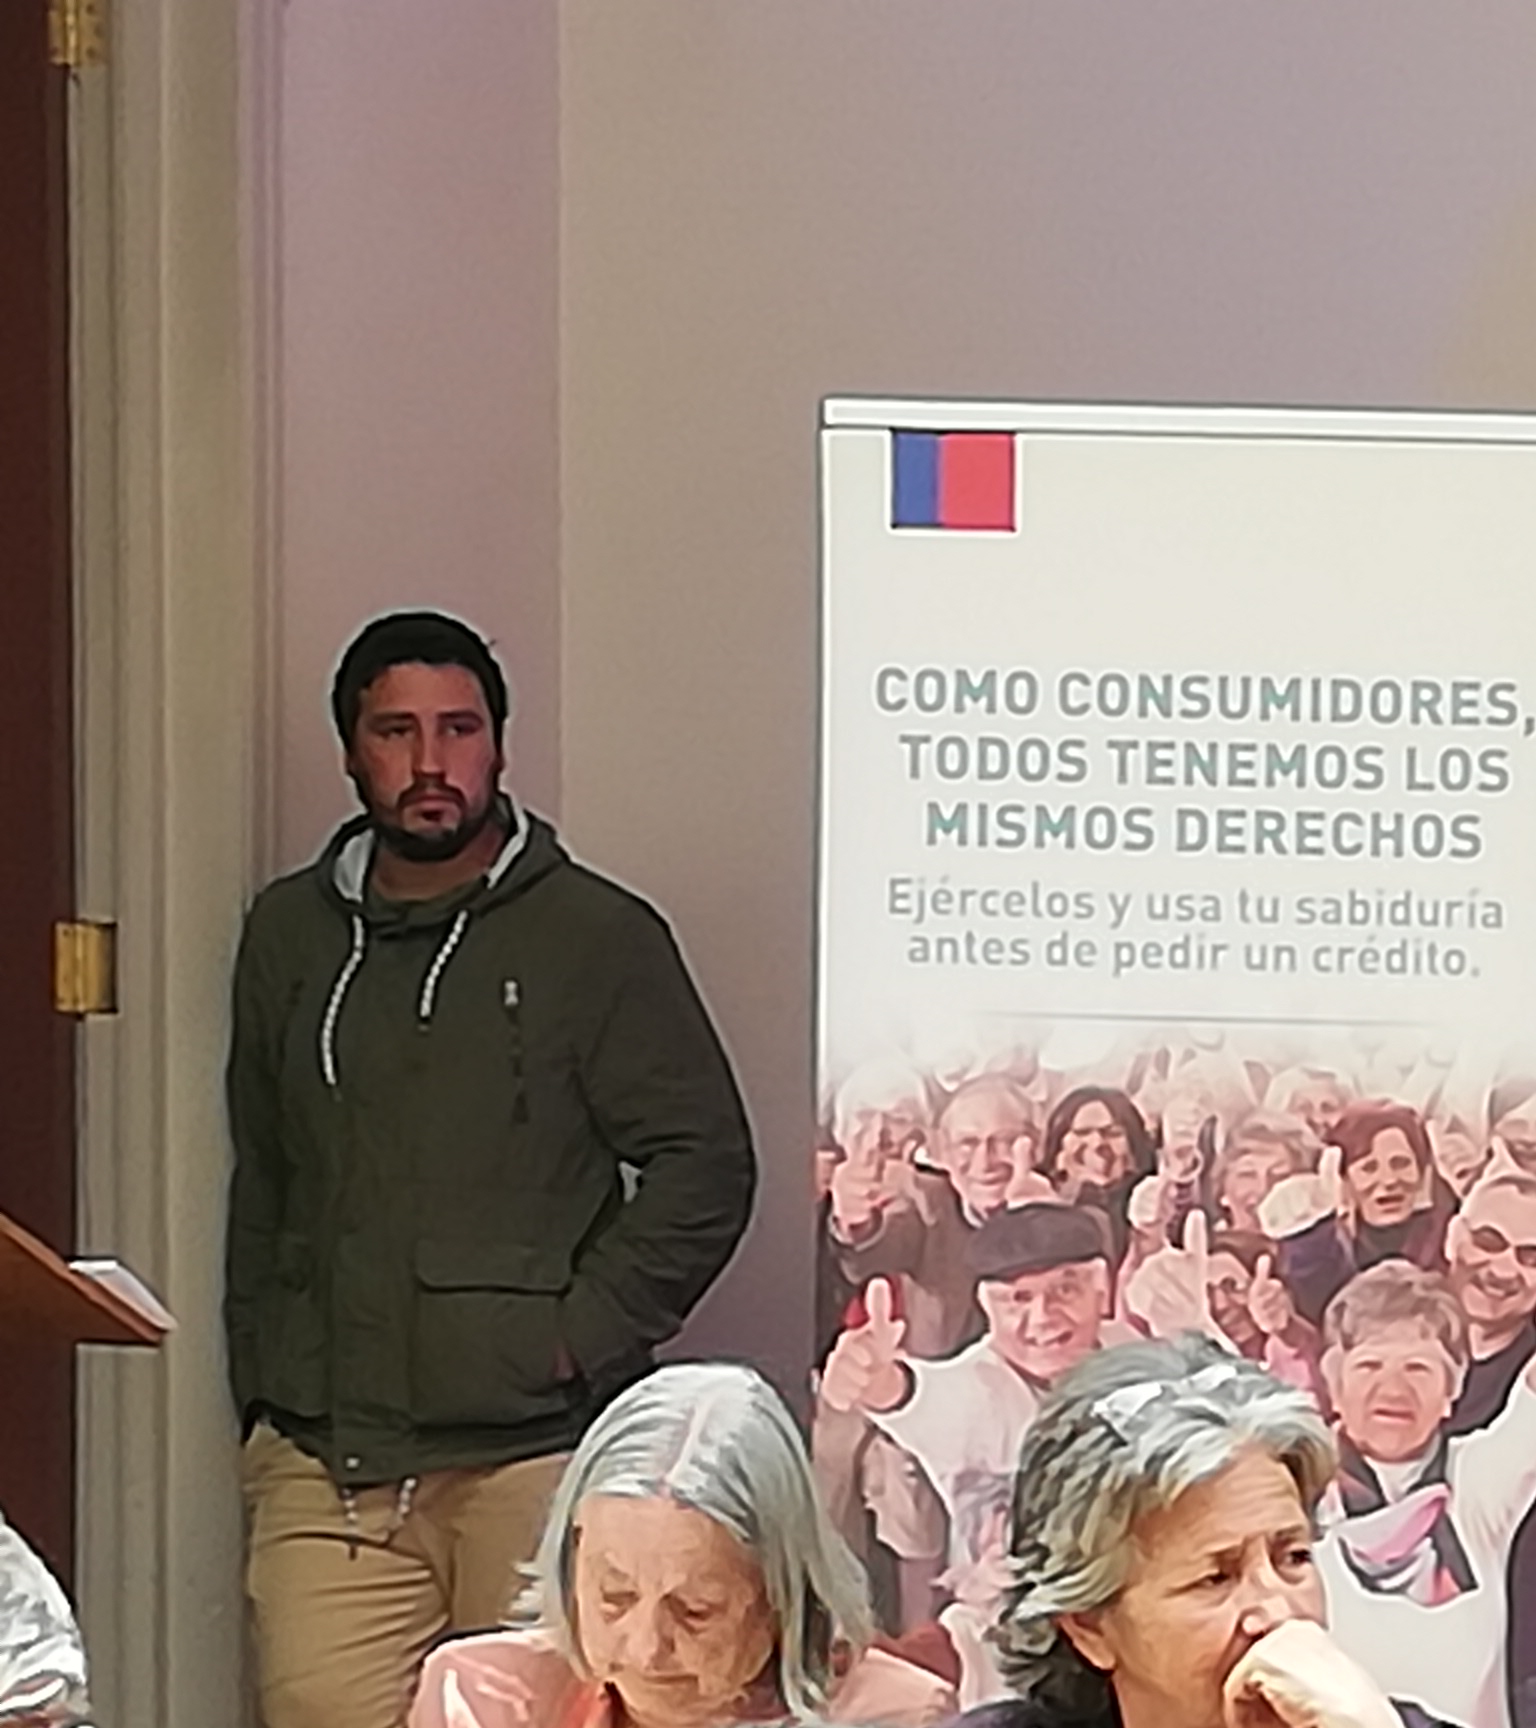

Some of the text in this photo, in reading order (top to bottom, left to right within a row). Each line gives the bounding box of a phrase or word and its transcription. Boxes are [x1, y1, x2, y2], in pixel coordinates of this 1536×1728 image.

[877, 668, 1535, 737] COMO CONSUMIDORES,
[899, 734, 1508, 792] TODOS TENEMOS LOS
[927, 802, 1481, 858] MISMOS DERECHOS
[889, 876, 1502, 929] Ejércelos y usa tu sabiduría
[908, 931, 1479, 977] antes de pedir un crédito.
